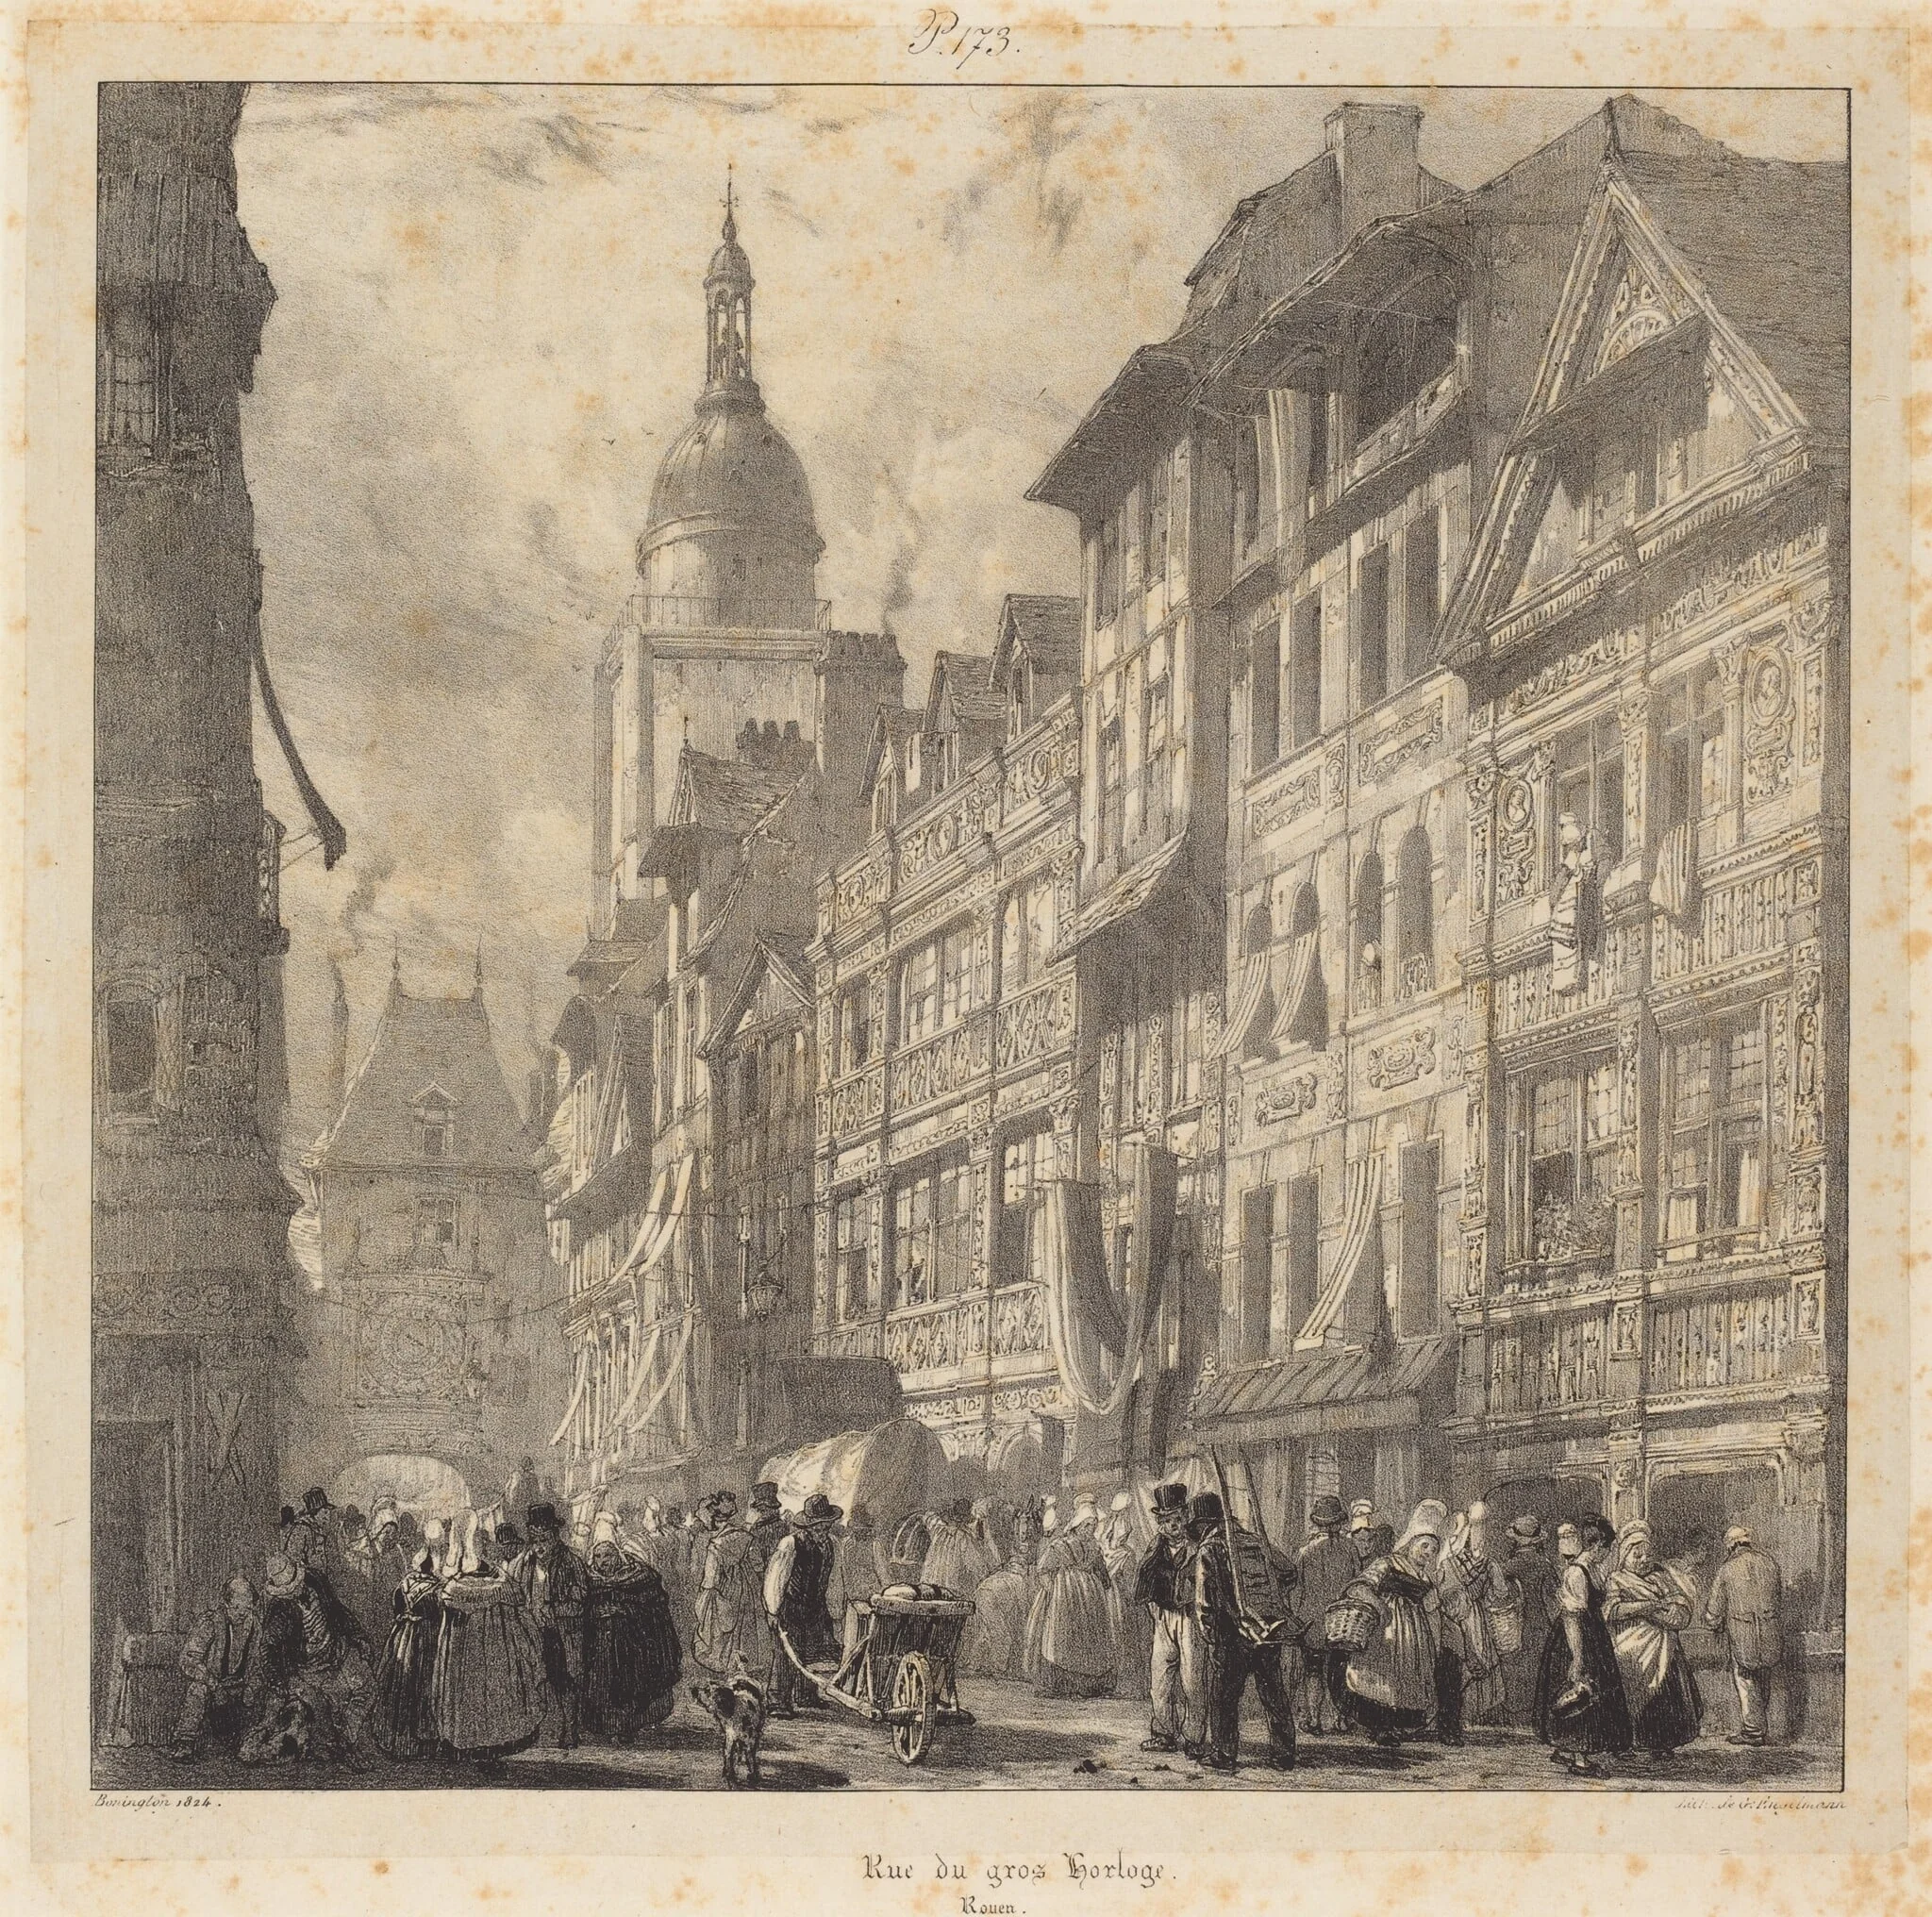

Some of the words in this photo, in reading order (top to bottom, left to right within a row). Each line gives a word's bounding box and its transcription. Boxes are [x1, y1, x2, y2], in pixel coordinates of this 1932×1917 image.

[861, 1853, 914, 1881] Rue
[935, 1853, 968, 1880] du
[987, 1862, 1047, 1889] gros
